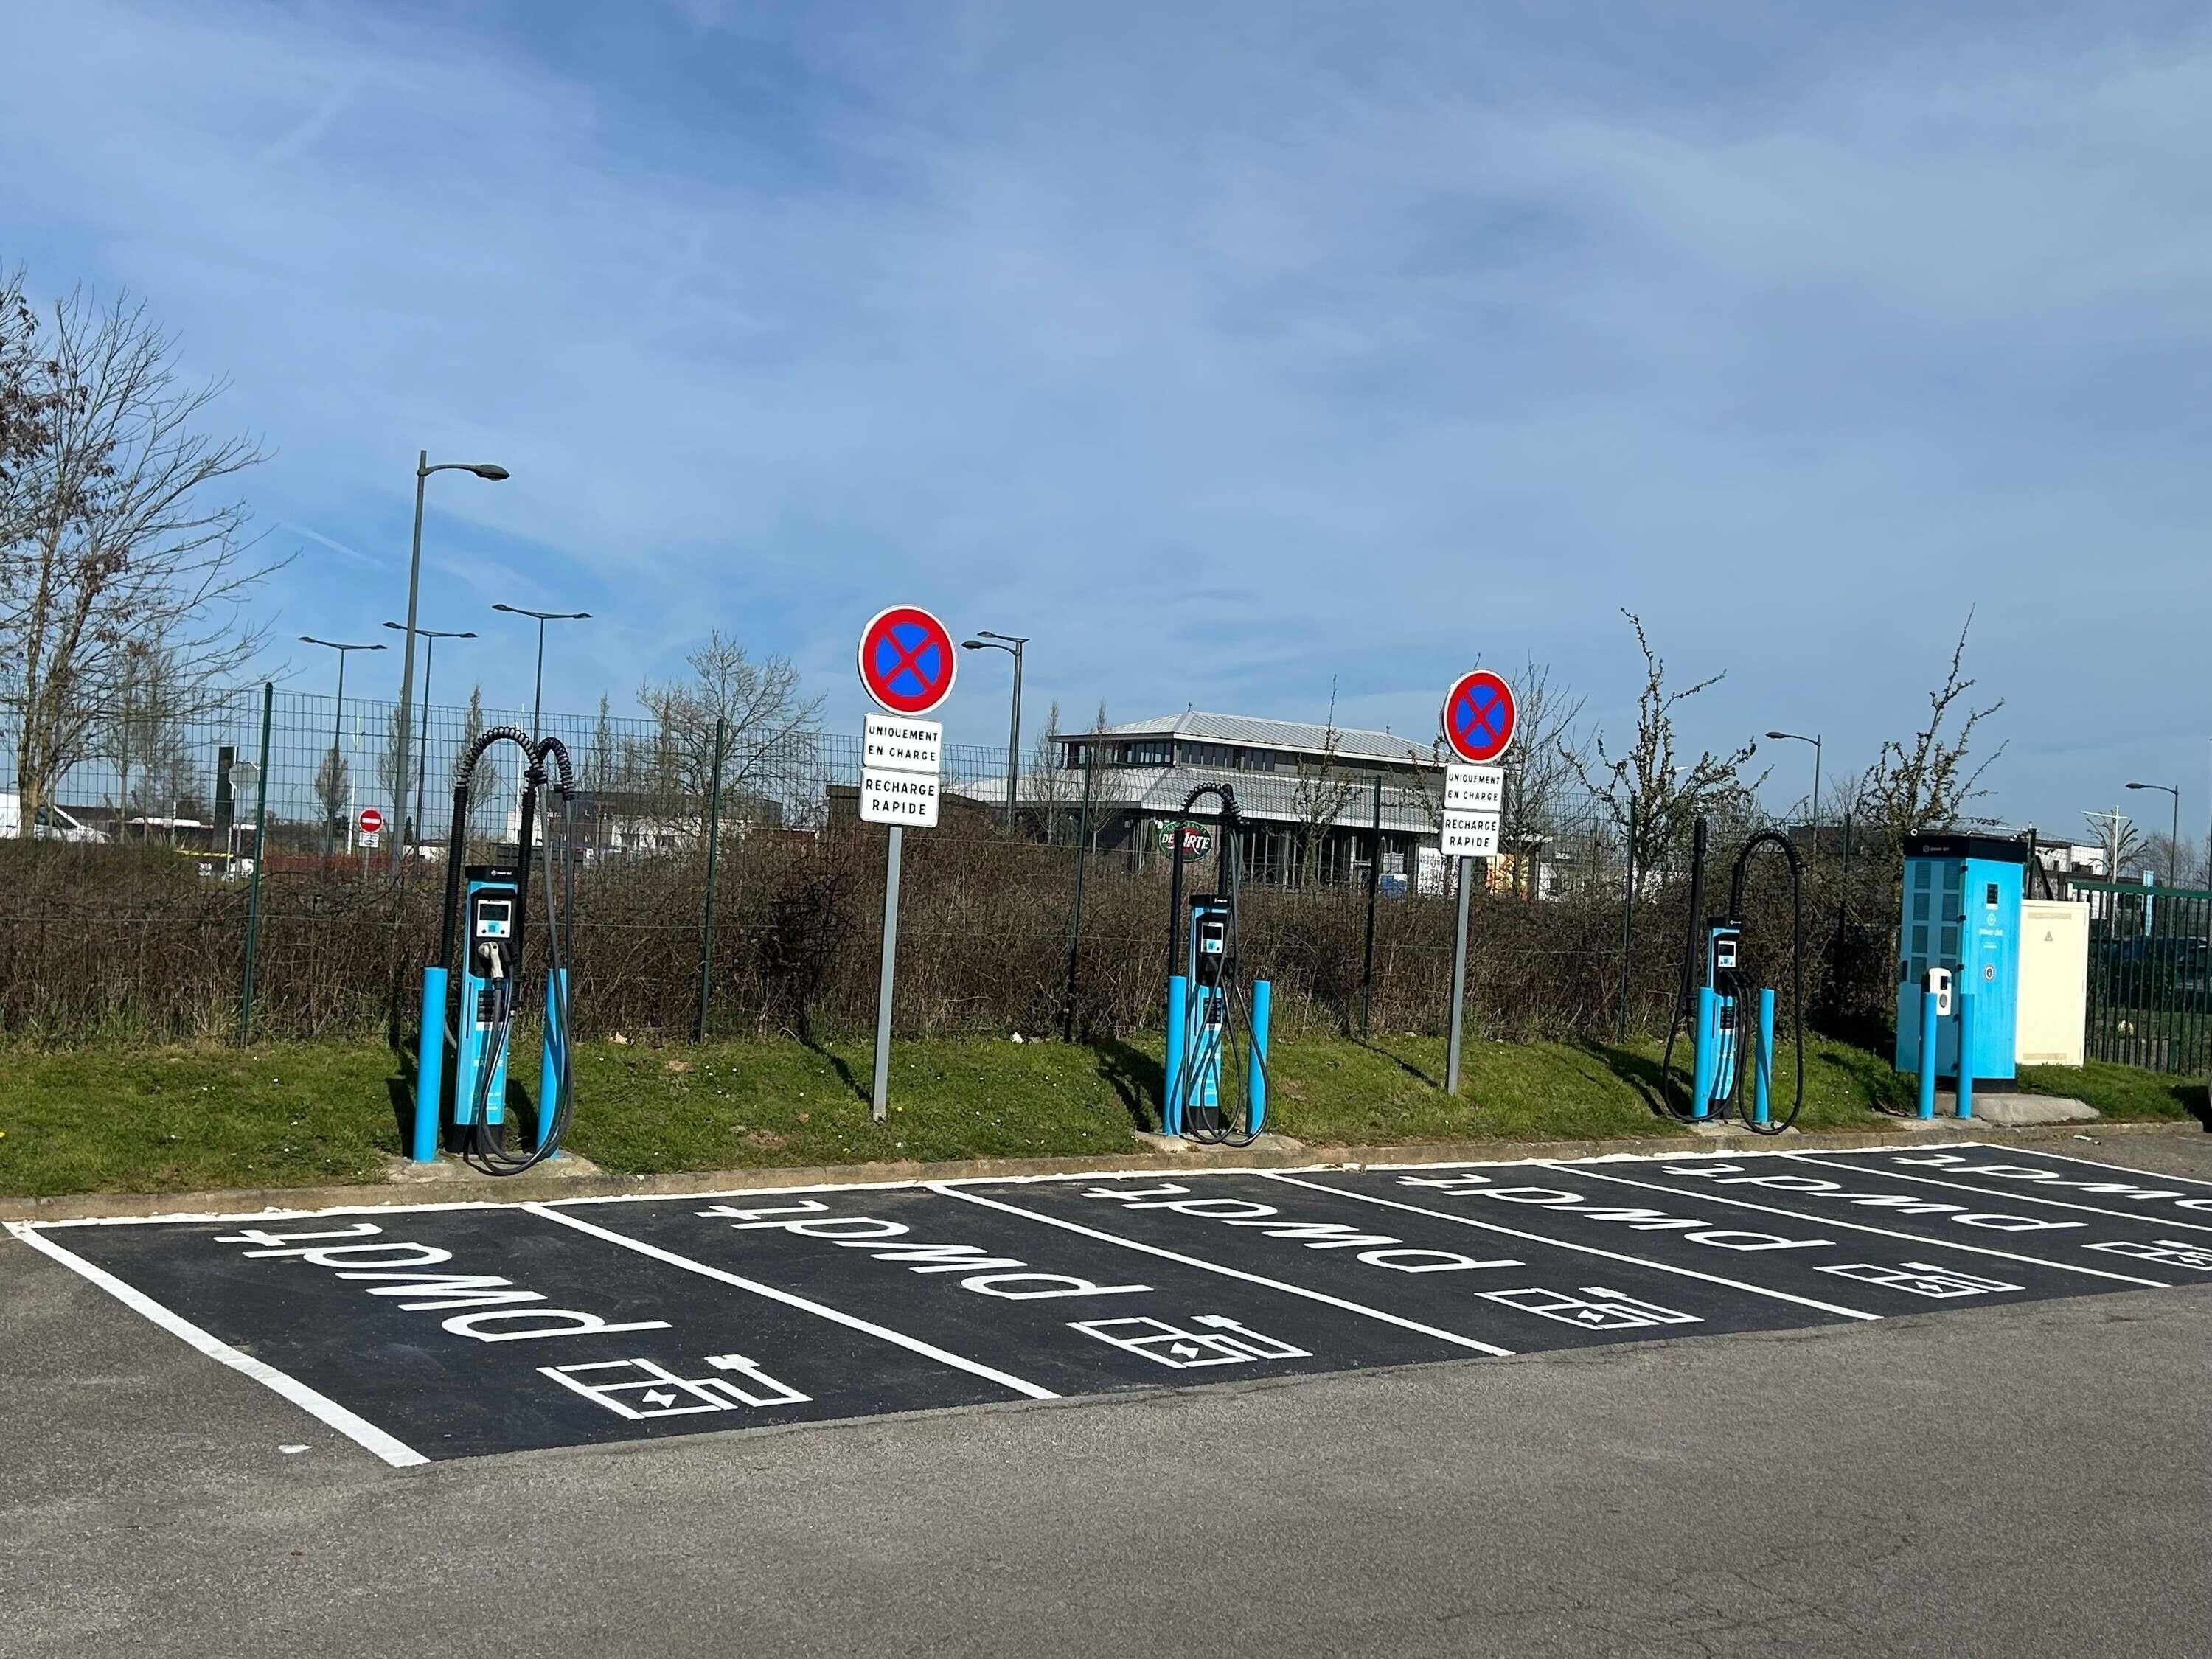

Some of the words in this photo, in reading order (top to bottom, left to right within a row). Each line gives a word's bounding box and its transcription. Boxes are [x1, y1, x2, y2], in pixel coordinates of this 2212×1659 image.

[869, 726, 938, 742] UNIQUEMENT
[869, 745, 883, 755] EN
[889, 748, 936, 762] CHARGE
[1448, 773, 1500, 785] UNIQUEMENT
[866, 779, 935, 796] RECHARGE
[1447, 790, 1459, 799] EN
[1463, 791, 1498, 801] CHARGE
[872, 799, 926, 815] RAPIDE
[1445, 819, 1497, 832] RECHARGE
[1450, 836, 1490, 847] RAPIDE
